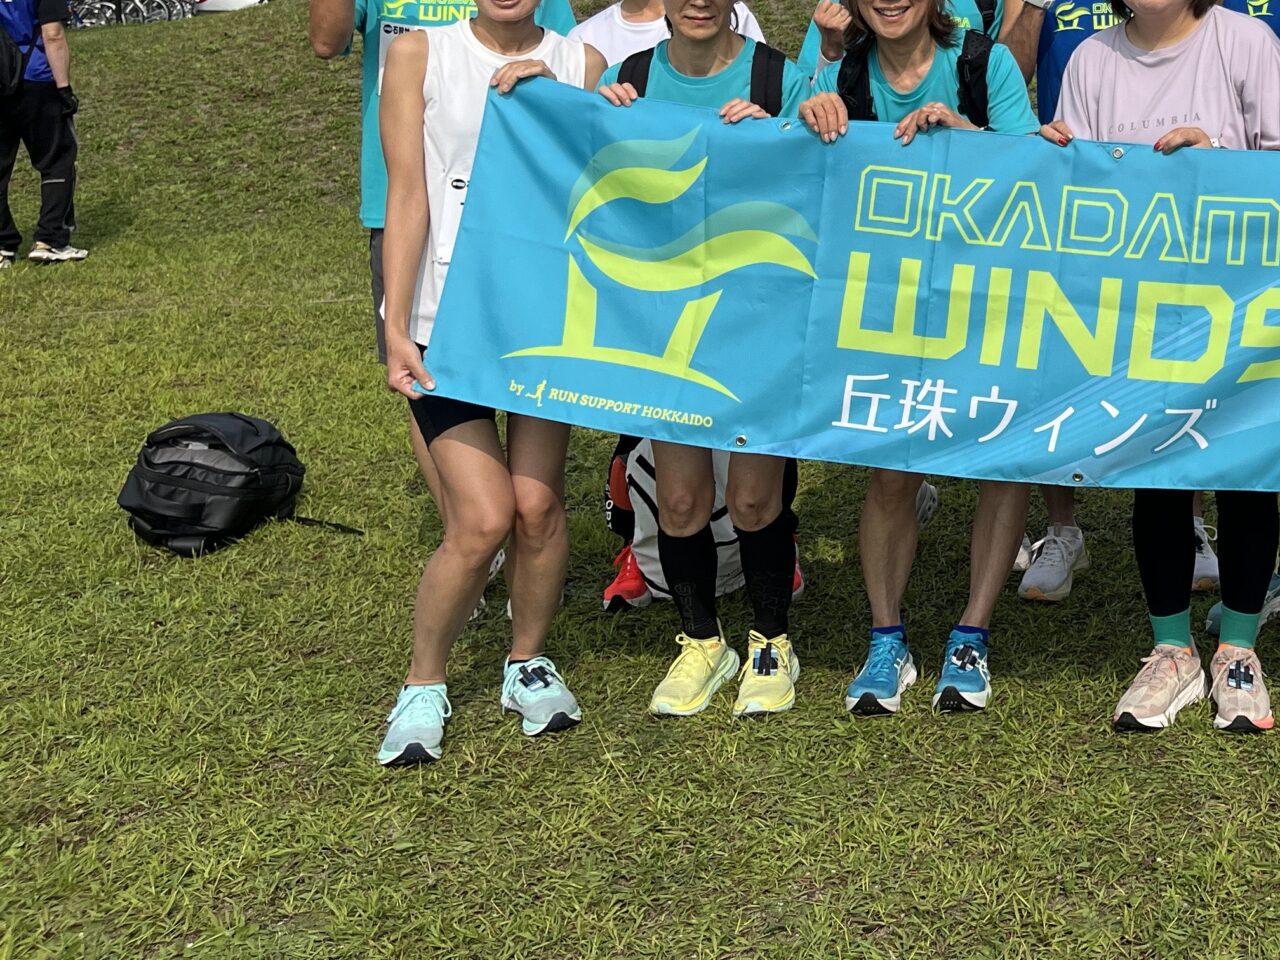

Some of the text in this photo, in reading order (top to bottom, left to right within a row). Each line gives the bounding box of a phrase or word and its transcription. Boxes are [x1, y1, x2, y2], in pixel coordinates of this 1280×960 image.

[1108, 112, 1201, 134] COLUMBIA
[509, 379, 714, 427] by RUN SUPPORT HOKKAIDO
[832, 374, 1217, 455] 丘珠ウィンズ
